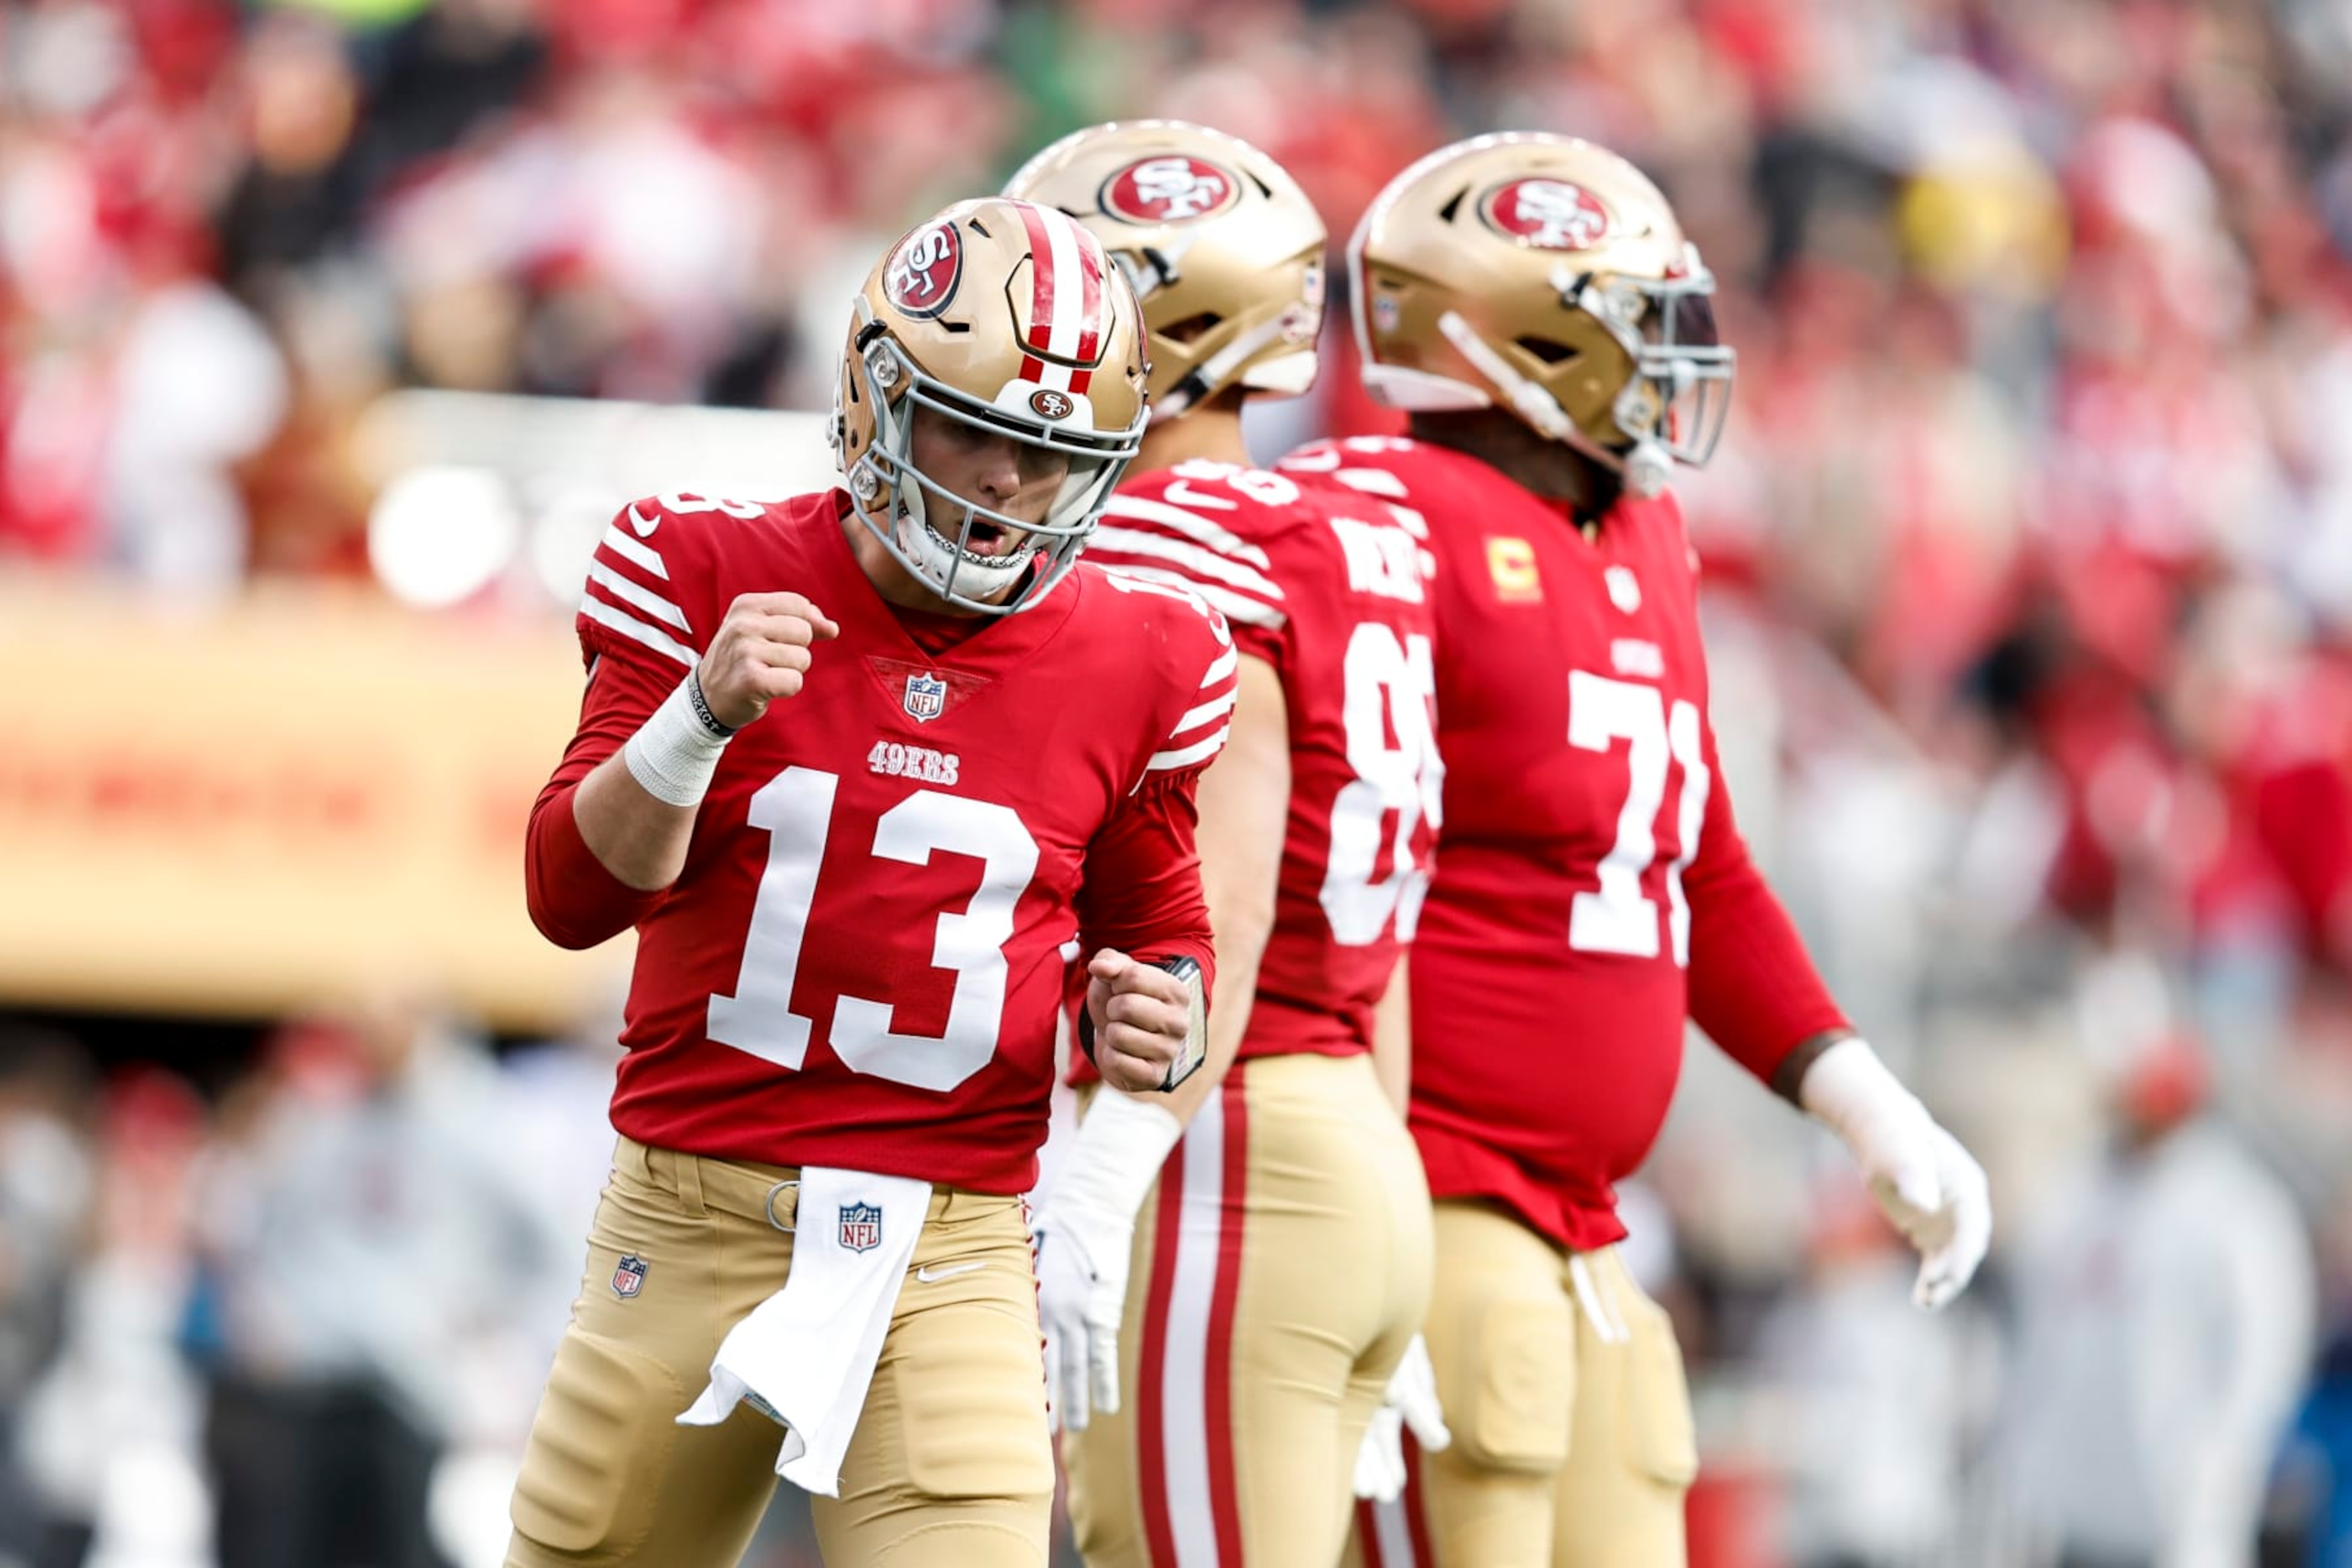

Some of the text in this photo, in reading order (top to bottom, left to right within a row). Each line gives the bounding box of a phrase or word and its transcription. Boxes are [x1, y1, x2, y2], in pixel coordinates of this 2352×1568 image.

[910, 695, 937, 713] NFL
[867, 741, 960, 785] 49ERS
[706, 765, 1040, 1093] 13
[843, 1224, 876, 1248] NFL
[616, 1270, 636, 1291] NFL
